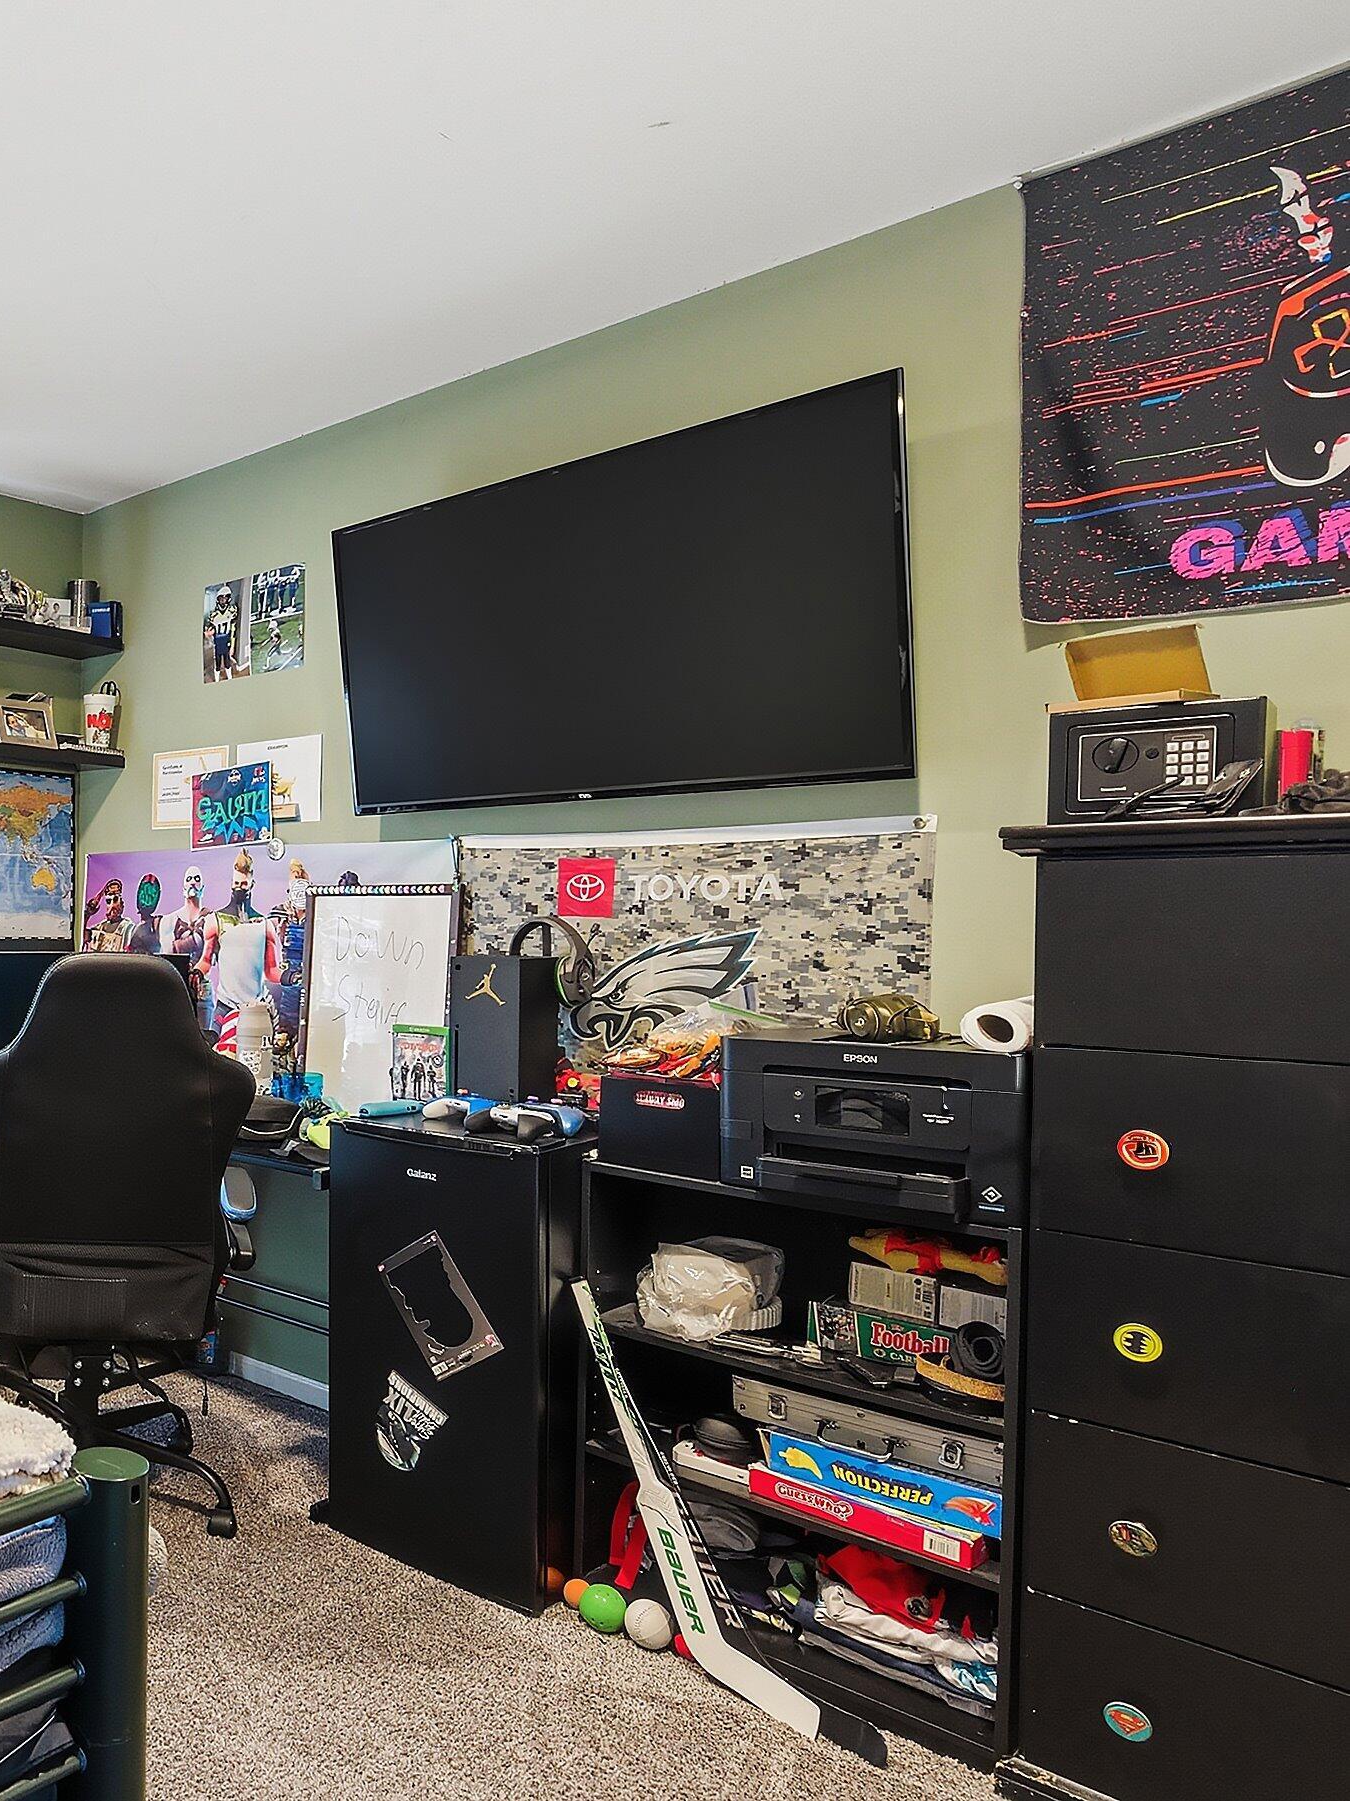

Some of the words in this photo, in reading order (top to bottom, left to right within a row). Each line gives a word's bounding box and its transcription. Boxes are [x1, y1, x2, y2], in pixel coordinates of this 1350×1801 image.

[628, 873, 785, 903] TOYOTA
[842, 1053, 878, 1064] EPSON
[406, 1168, 437, 1182] Galanz
[870, 1321, 950, 1354] Football
[831, 1463, 934, 1505] PERFECTION
[656, 1527, 706, 1634] BAUER
